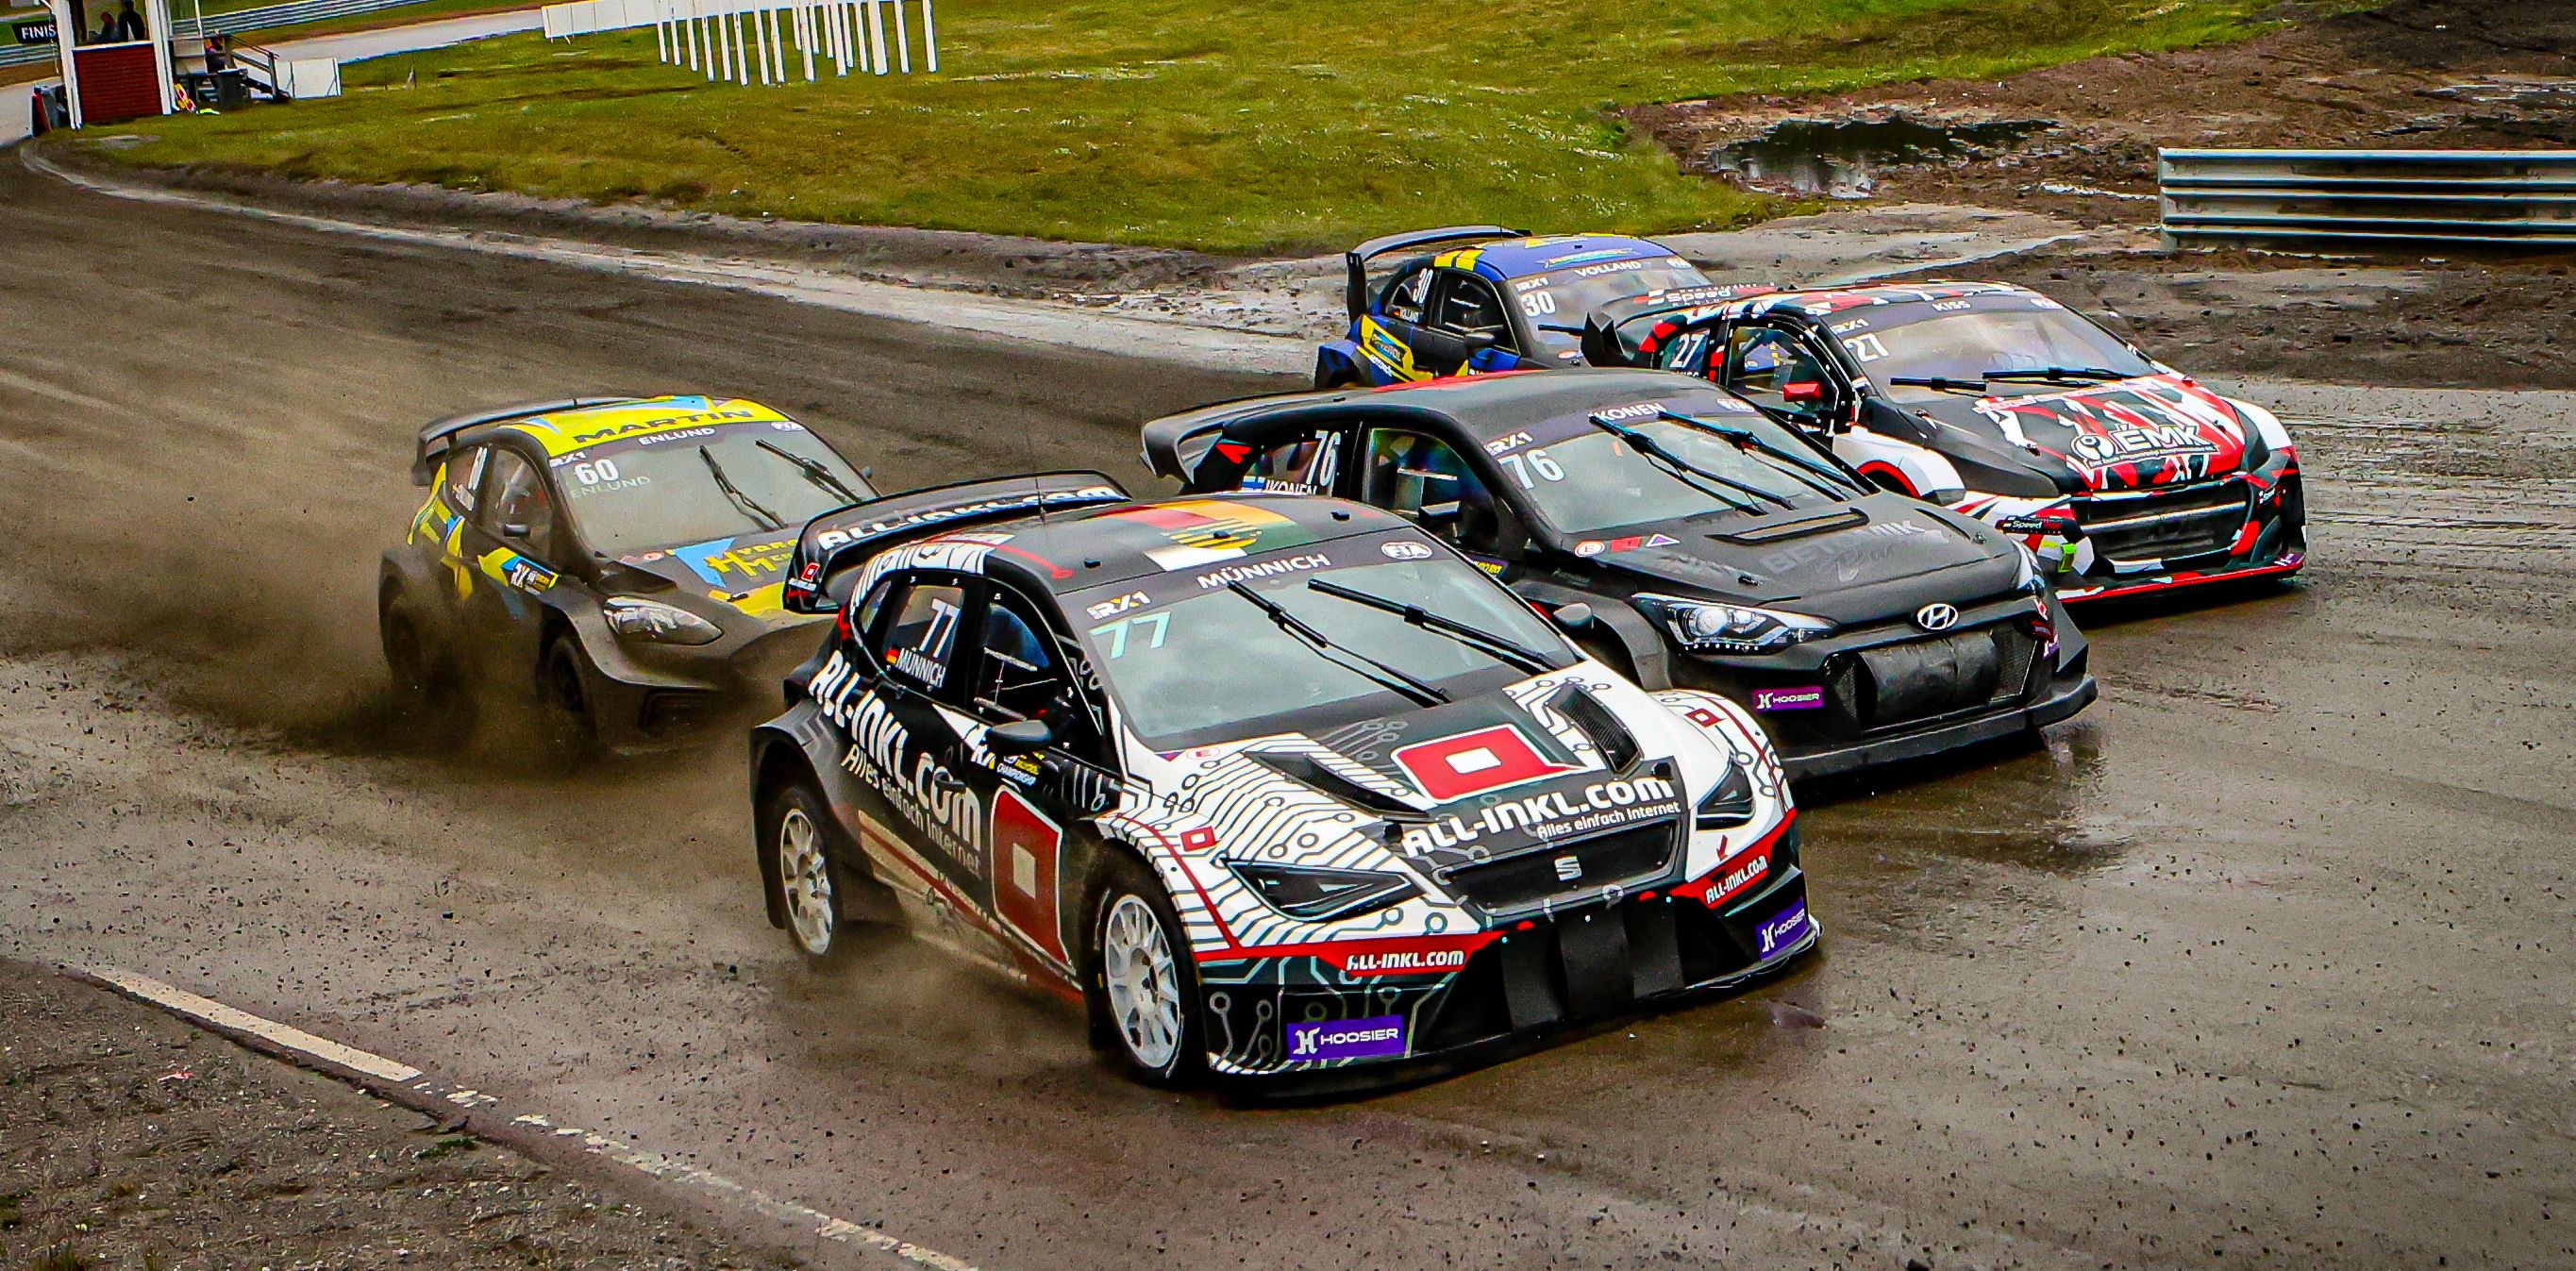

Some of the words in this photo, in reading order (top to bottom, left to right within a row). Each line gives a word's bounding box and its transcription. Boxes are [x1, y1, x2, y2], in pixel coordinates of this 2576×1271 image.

[22, 24, 57, 39] FINIS
[1575, 260, 1642, 277] VOLLAND
[1413, 268, 1433, 303] 30
[1665, 287, 1731, 303] Speed
[1520, 291, 1556, 317] 30
[1932, 300, 1972, 311] KISS
[1669, 329, 1710, 369] 27
[1844, 333, 1889, 362] 27
[573, 410, 754, 443] MARTIN
[639, 427, 716, 445] ENLUND
[2116, 422, 2208, 453] ÉMK
[575, 459, 619, 485] 60
[1306, 430, 1341, 486] 76
[1498, 448, 1565, 490] 76
[570, 476, 651, 499] ENLUND
[1265, 479, 1317, 495] IKONEN
[1389, 544, 1431, 559] FIA
[1197, 553, 1331, 589] MÜNNICH
[919, 598, 961, 658] 77
[1089, 611, 1172, 659] 77
[895, 646, 946, 688] MÜNNICH
[1773, 694, 1820, 704] HOOSIER
[840, 744, 879, 789] Alles
[1536, 821, 1573, 840] Alles
[1576, 811, 1625, 832] einfach
[1628, 801, 1681, 822] Internet
[1320, 1028, 1398, 1045] HOOSIER
